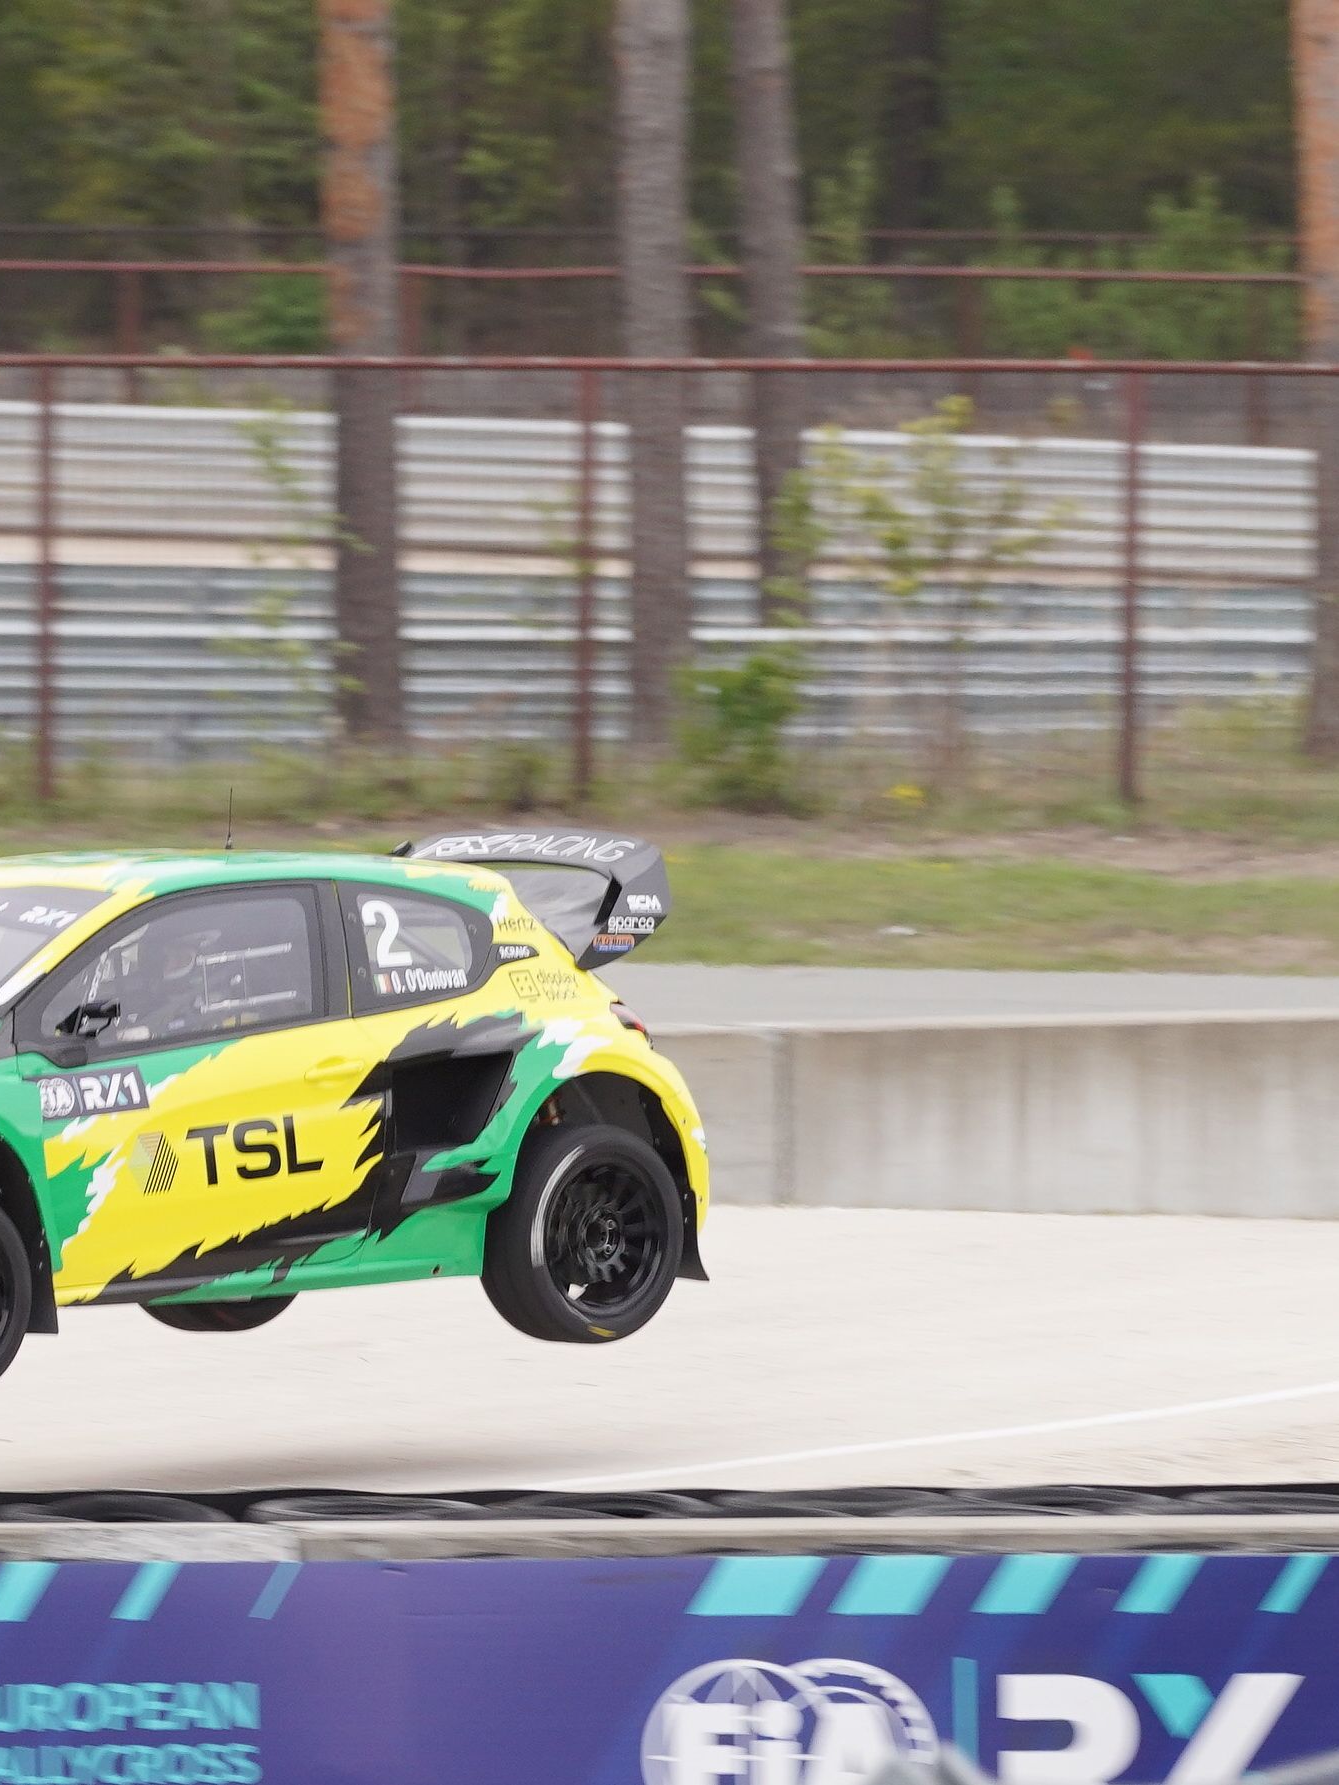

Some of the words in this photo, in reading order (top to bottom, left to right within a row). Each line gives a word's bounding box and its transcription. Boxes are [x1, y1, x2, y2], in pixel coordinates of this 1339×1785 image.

[491, 834, 635, 862] RACING
[361, 900, 412, 968] 2
[608, 916, 655, 935] sparco
[79, 1071, 141, 1111] RX1
[186, 1114, 324, 1186] TSL
